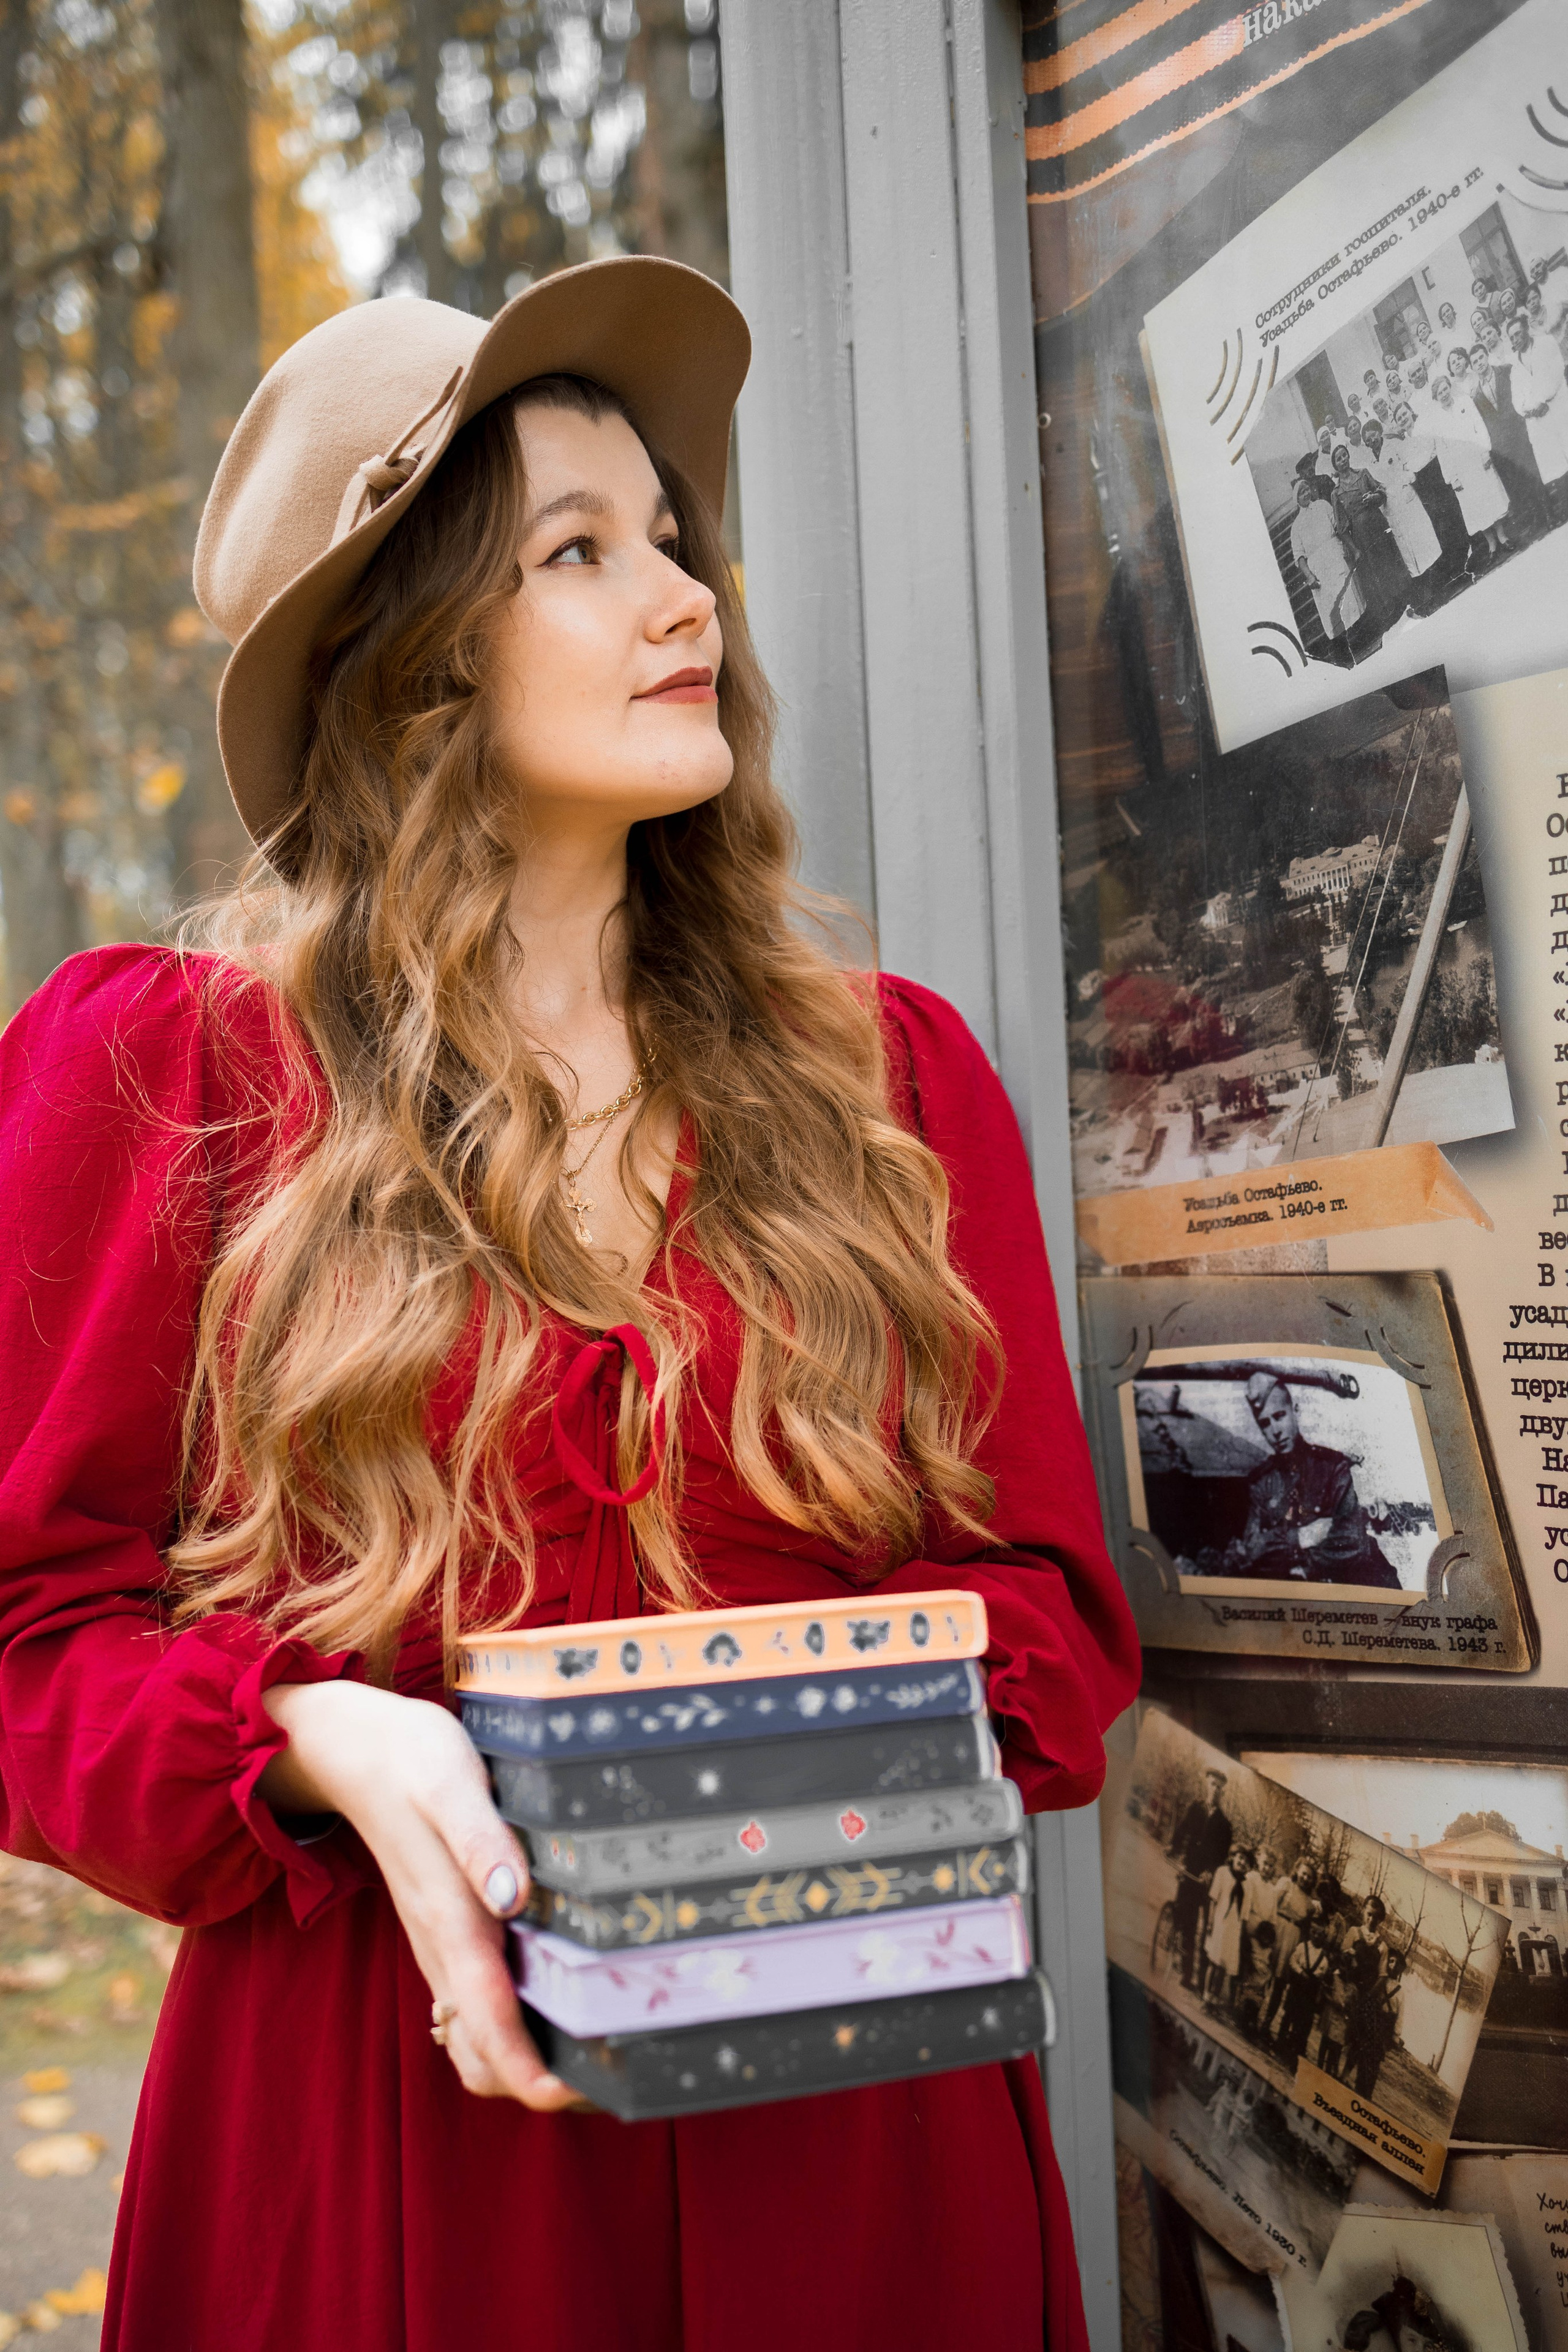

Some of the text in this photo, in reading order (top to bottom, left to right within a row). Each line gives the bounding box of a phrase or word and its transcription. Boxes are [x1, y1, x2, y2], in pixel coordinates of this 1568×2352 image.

[1242, 0, 1327, 47] нак
[1256, 186, 1431, 328] Сотрудники госпиталя.
[1259, 167, 1483, 347] Усадьба Остафьево. 1940-е гг.
[1183, 1179, 1322, 1212] Усадьба Остафьево.
[1280, 1200, 1325, 1219] 1940-е
[1330, 1199, 1348, 1211] гг.
[1538, 1231, 1568, 1250] ве
[1537, 1263, 1555, 1287] В
[1520, 1415, 1568, 1441] дву
[1221, 1605, 1286, 1621] Василий
[1291, 1608, 1378, 1626] Шереметев
[1401, 1615, 1441, 1630] внук
[1446, 1615, 1498, 1633] графа
[1303, 1630, 1507, 1653] С.Д. Шереметева. 1943 г.
[1313, 2092, 1425, 2175] Въездная аллея
[1351, 2100, 1425, 2158] Остафьево.
[1232, 2192, 1261, 2224] Лето
